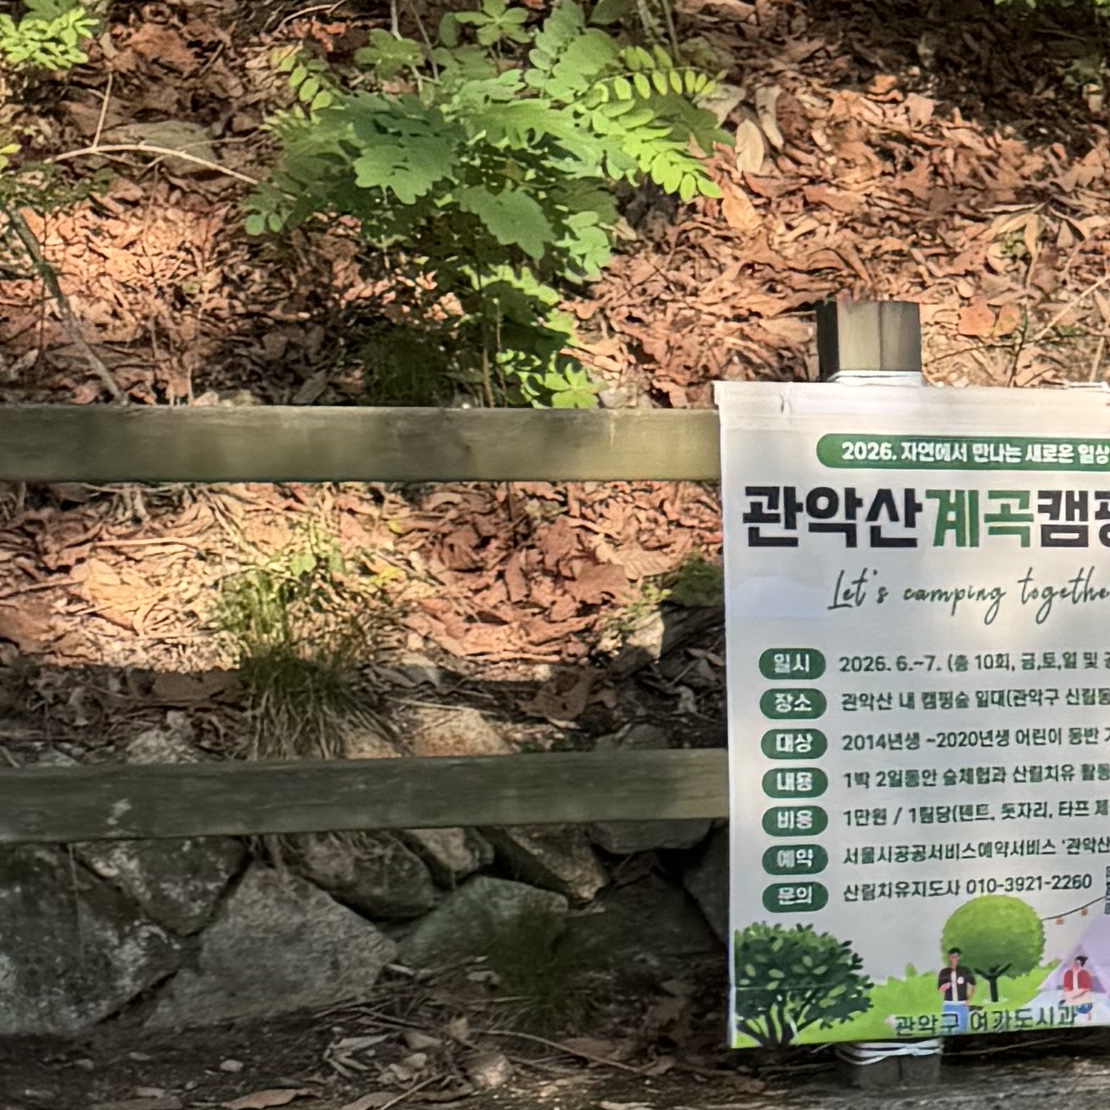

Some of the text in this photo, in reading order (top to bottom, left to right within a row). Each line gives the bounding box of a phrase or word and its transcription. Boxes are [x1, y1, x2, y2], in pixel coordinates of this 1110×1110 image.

[841, 441, 898, 461] 2026.
[900, 441, 968, 462] 자연에서
[972, 443, 1022, 464] 만나는
[1077, 444, 1110, 466] 일상
[826, 567, 889, 612] Let's
[902, 584, 1007, 626] camping
[773, 652, 811, 674] 일시
[839, 655, 892, 673] 2026.
[896, 655, 943, 672] 6.~7.
[975, 653, 1016, 673] 10회,
[1083, 651, 1098, 670] 및
[774, 692, 813, 713] 장소
[841, 691, 892, 711] 관악산
[899, 690, 915, 710] 내
[921, 690, 970, 710] 캠핑숲
[775, 732, 814, 753] 대상
[842, 731, 920, 752] 2014년생
[1016, 726, 1062, 747] 어린이
[1067, 725, 1099, 746] 동반
[776, 771, 813, 792] 내용
[843, 771, 870, 790] 1박
[875, 768, 938, 789] 2일동안
[1012, 763, 1076, 784] 산림치유
[777, 809, 813, 830] 비용
[843, 807, 888, 827] 1만원
[1001, 801, 1054, 822] 돗자리,
[1058, 799, 1090, 819] 타프
[776, 848, 814, 868] 예약
[778, 885, 813, 906] 문의
[843, 873, 1093, 902] 산림치유지도사 010-3921-2260
[895, 1013, 960, 1036] 관악구
